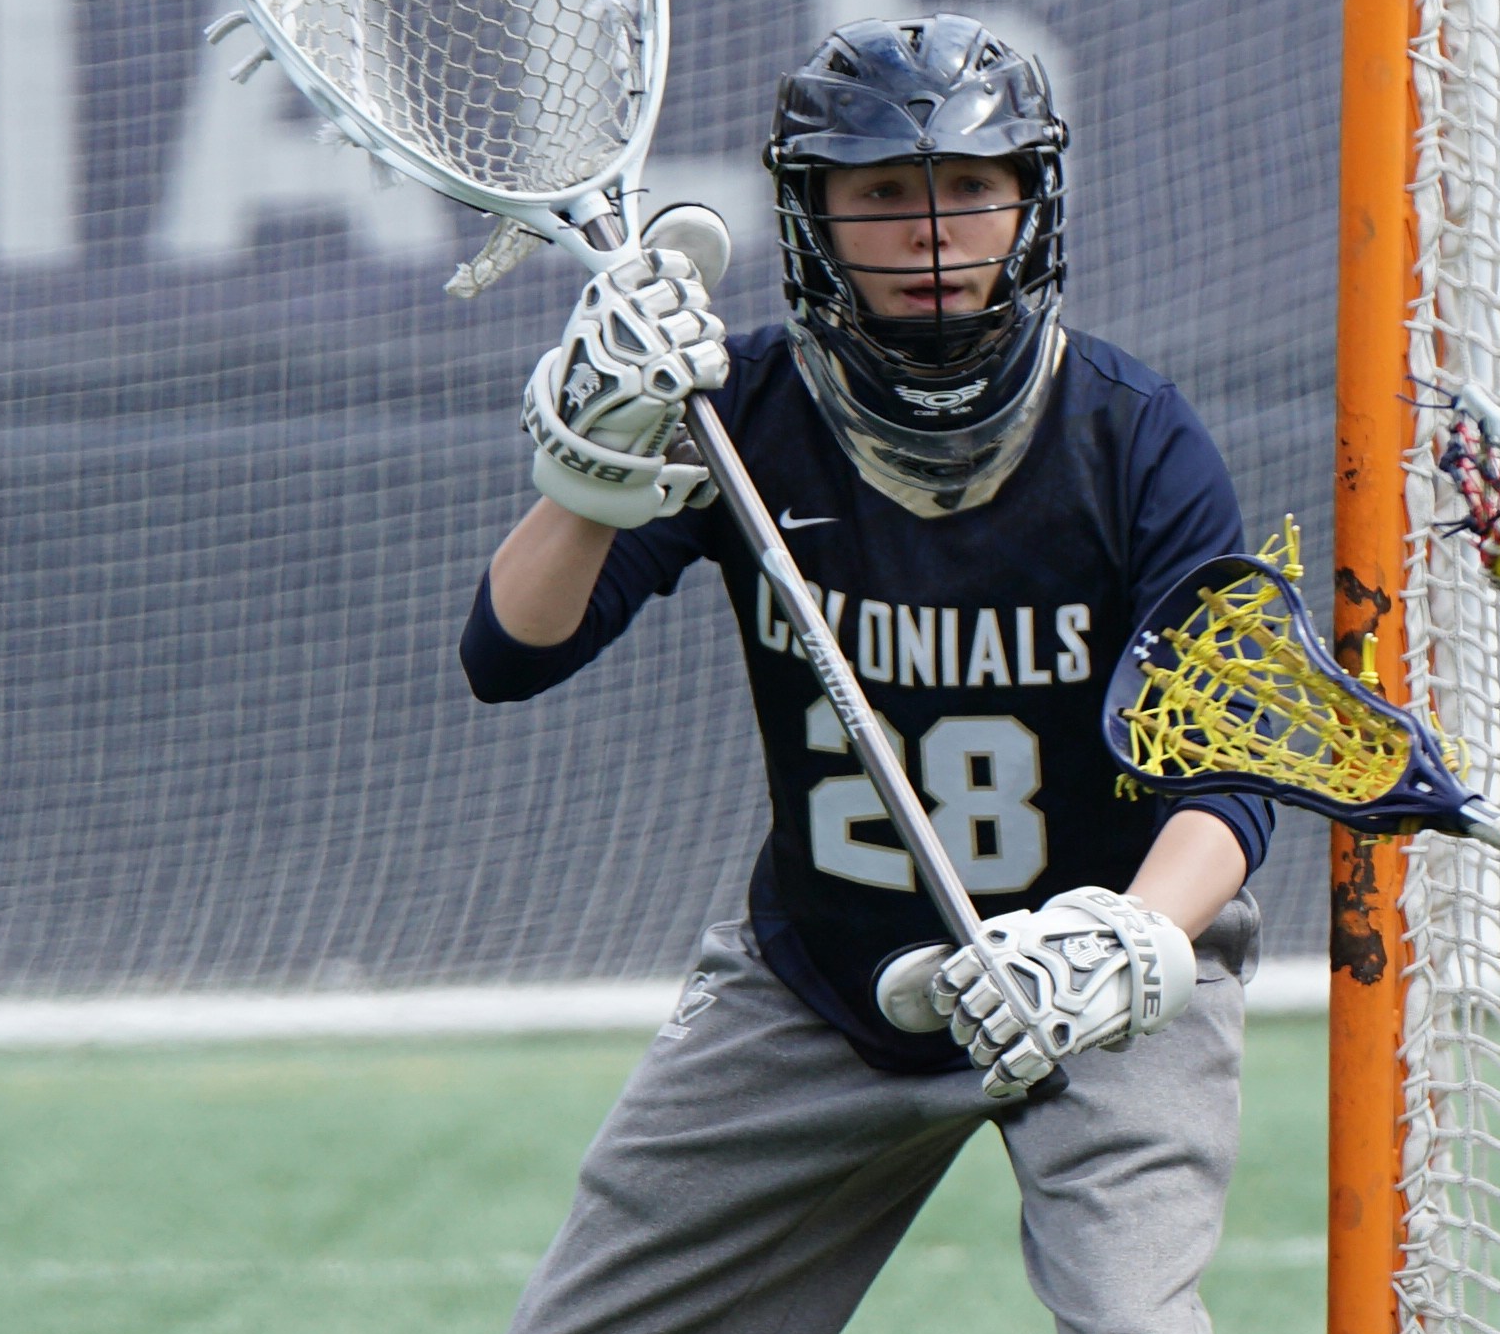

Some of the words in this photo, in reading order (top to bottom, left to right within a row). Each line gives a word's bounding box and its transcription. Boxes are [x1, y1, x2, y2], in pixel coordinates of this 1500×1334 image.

[524, 384, 633, 483] BRINE
[802, 627, 875, 740] VANDAL
[805, 695, 1048, 895] 28
[1085, 893, 1162, 1019] BRINE
